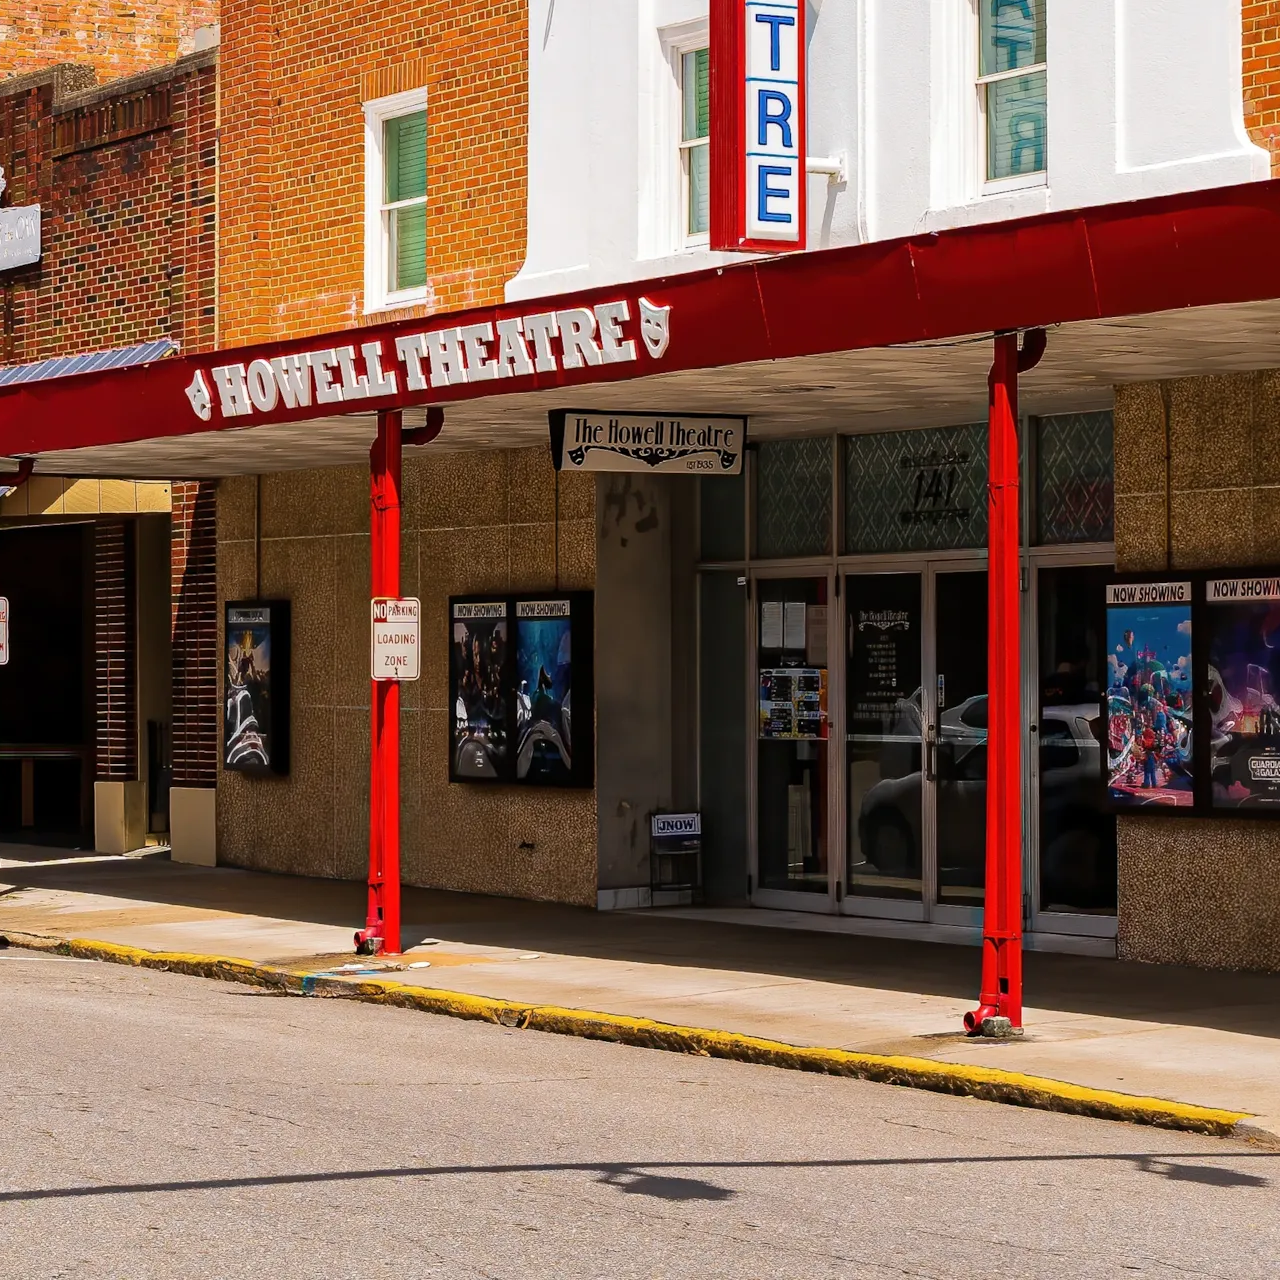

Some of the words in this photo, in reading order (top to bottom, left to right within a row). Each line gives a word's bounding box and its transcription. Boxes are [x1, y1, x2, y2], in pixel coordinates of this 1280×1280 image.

[211, 341, 398, 418] HOWELL
[396, 299, 638, 392] THEATRE
[574, 418, 604, 444] The
[608, 419, 664, 446] Howell
[668, 421, 734, 448] Theatre
[914, 467, 956, 509] 141
[1113, 587, 1137, 603] NOW
[1138, 585, 1185, 602] SHOWING
[1213, 581, 1239, 598] NOW
[373, 603, 387, 619] NO
[388, 606, 417, 617] PARKING
[457, 605, 473, 617] NOW
[473, 604, 503, 617] SHOWING
[520, 604, 536, 616] NOW
[536, 603, 567, 616] SHOWING
[377, 634, 416, 645] LOADING
[384, 655, 408, 666] ZONE
